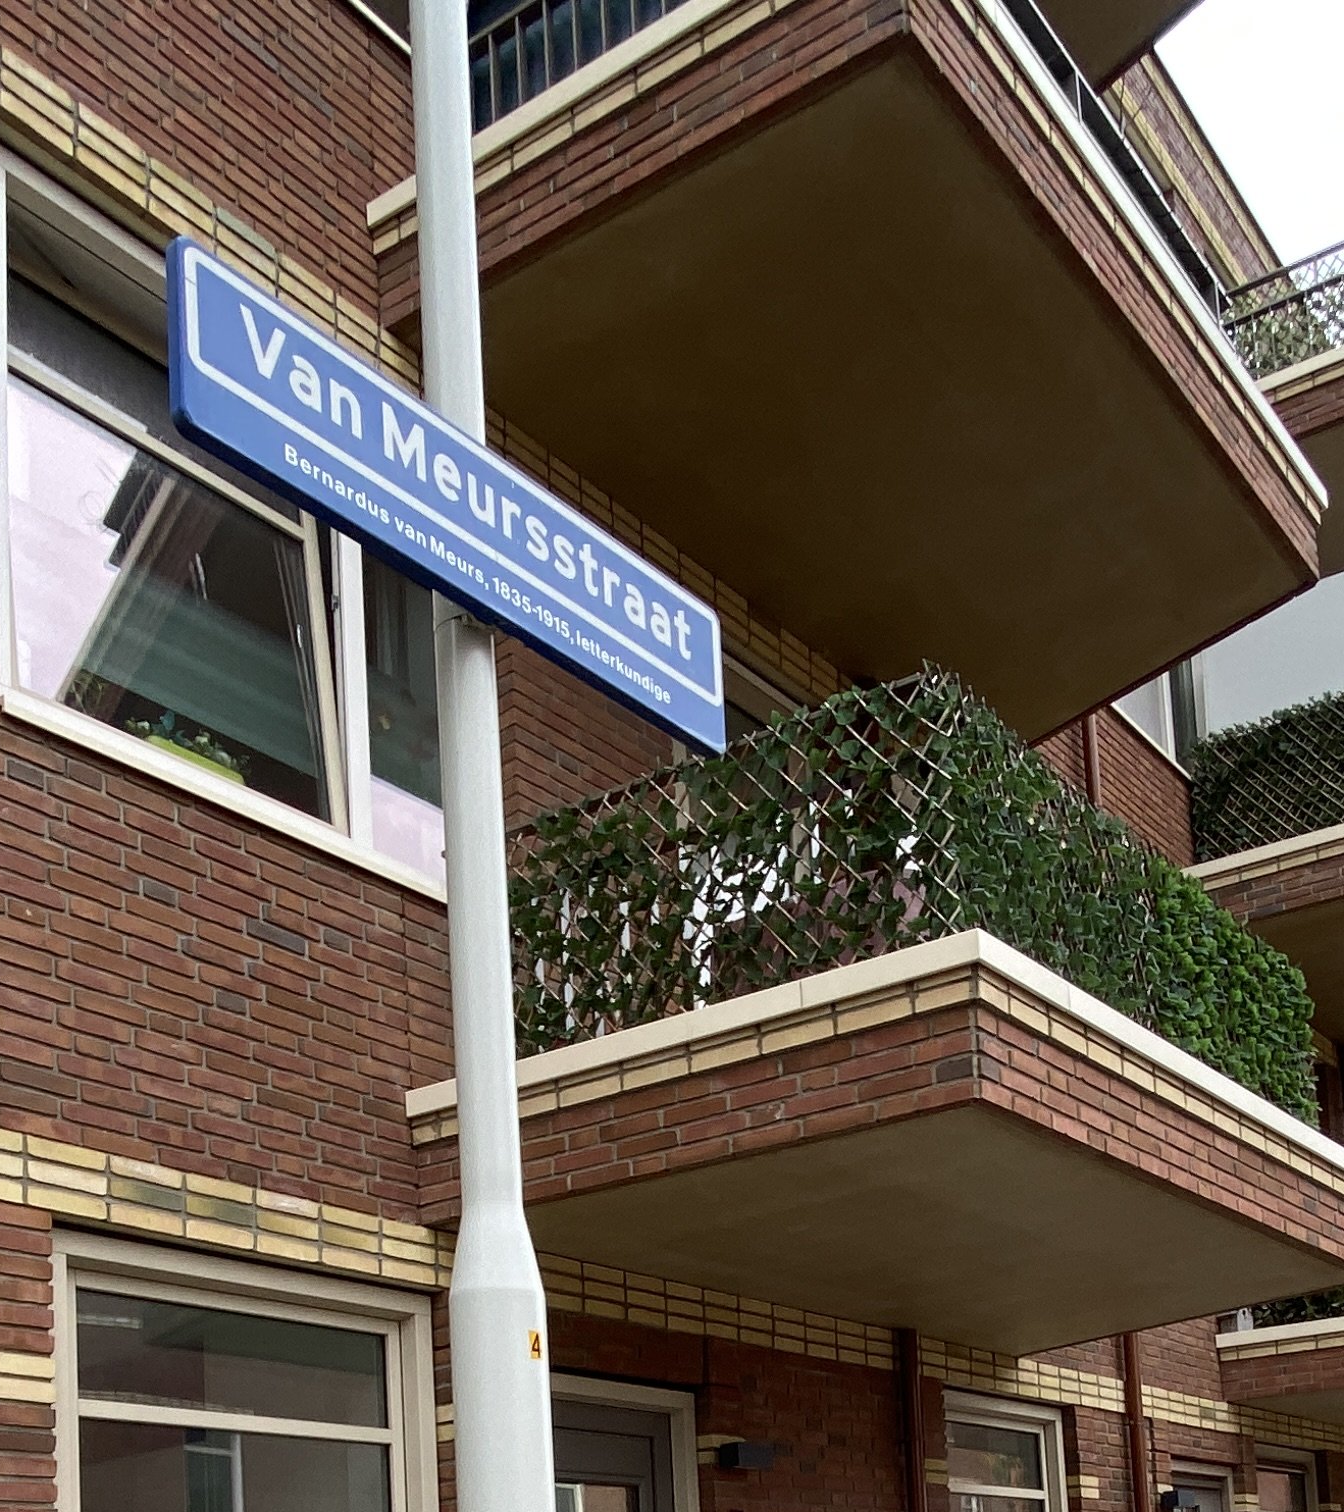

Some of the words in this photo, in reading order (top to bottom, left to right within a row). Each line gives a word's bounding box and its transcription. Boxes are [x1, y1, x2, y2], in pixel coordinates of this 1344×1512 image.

[239, 303, 364, 440] Van
[381, 401, 692, 661] Meursstraat
[284, 443, 391, 524] Bernardus
[394, 516, 427, 548] van
[429, 535, 491, 591] Meurs,
[492, 577, 576, 646] 1835-1915,
[575, 629, 672, 704] letterkundige
[531, 1332, 541, 1359] 4
